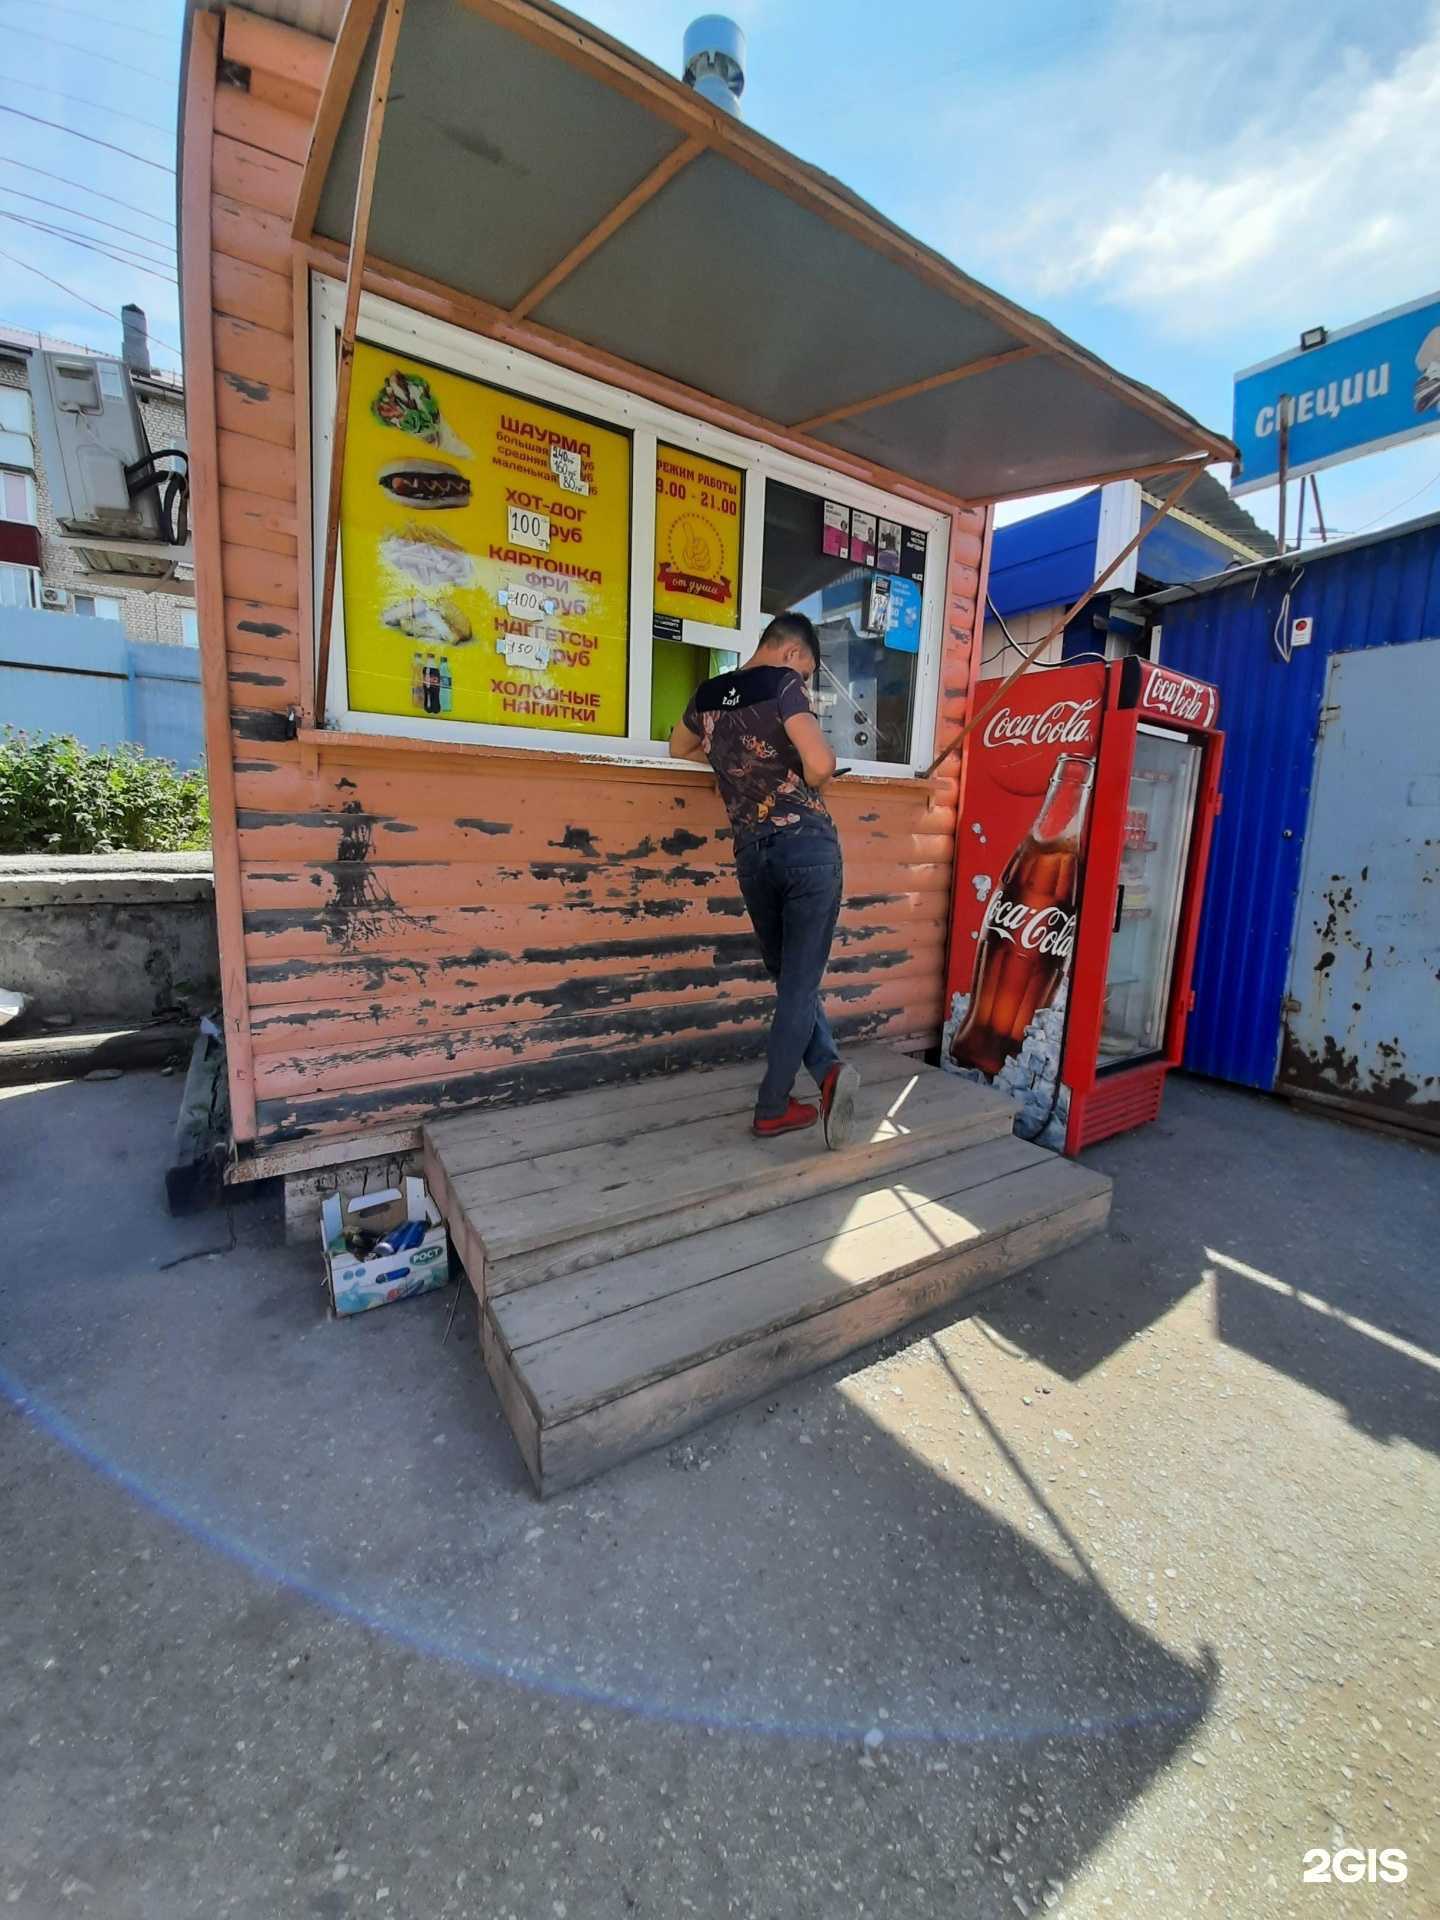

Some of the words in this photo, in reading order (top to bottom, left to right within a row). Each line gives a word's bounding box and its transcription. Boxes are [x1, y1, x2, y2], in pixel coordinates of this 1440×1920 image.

[496, 432, 548, 456] большая
[501, 415, 591, 457] ШАУРМА
[497, 445, 548, 468] средняя
[492, 457, 556, 483] маленькая
[698, 473, 737, 496] РАБОТЫ
[505, 488, 586, 521] ХОТ-ДОГ
[701, 491, 737, 516] 21.00
[511, 512, 541, 537] 100
[489, 545, 602, 584] КАРТОШКА
[526, 572, 569, 594] ФРИ
[513, 591, 537, 609] 100
[494, 618, 599, 650] НАГГЕТСЫ
[511, 641, 534, 655] 150
[491, 679, 601, 707] ХОЛОДНЫЕ
[1143, 668, 1204, 721] Coca-Cola
[503, 698, 596, 722] НАПИТКИ
[984, 699, 1101, 747] Coca-Cola
